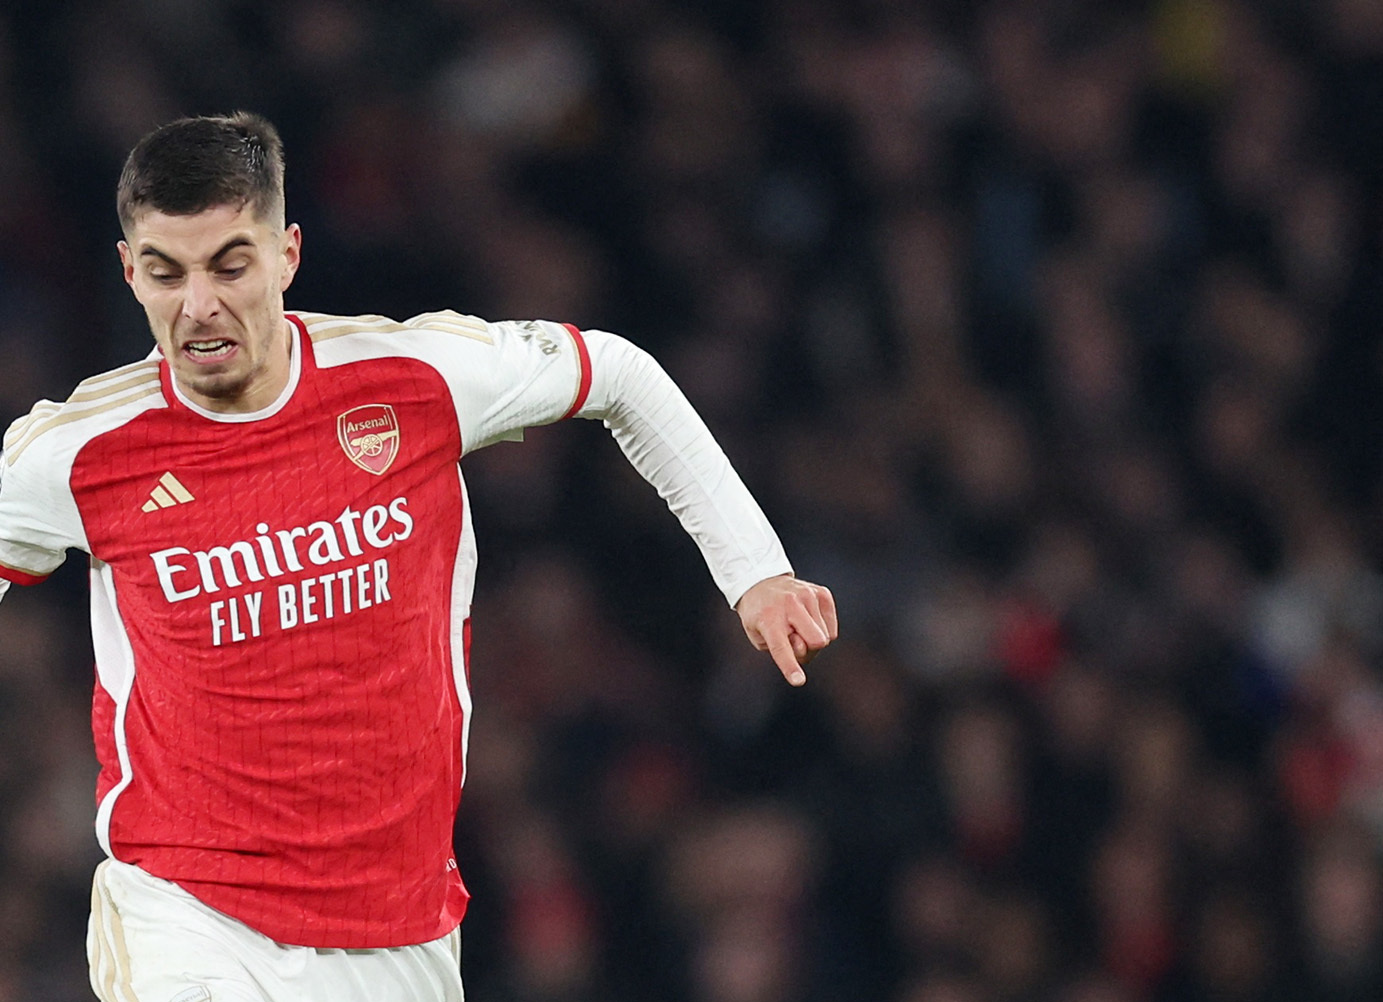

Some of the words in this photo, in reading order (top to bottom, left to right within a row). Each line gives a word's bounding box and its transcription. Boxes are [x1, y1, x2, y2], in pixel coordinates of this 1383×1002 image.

[346, 414, 389, 433] Arsenal
[149, 496, 414, 603] Emirates
[210, 591, 263, 646] FLY
[277, 558, 392, 630] BETTER
